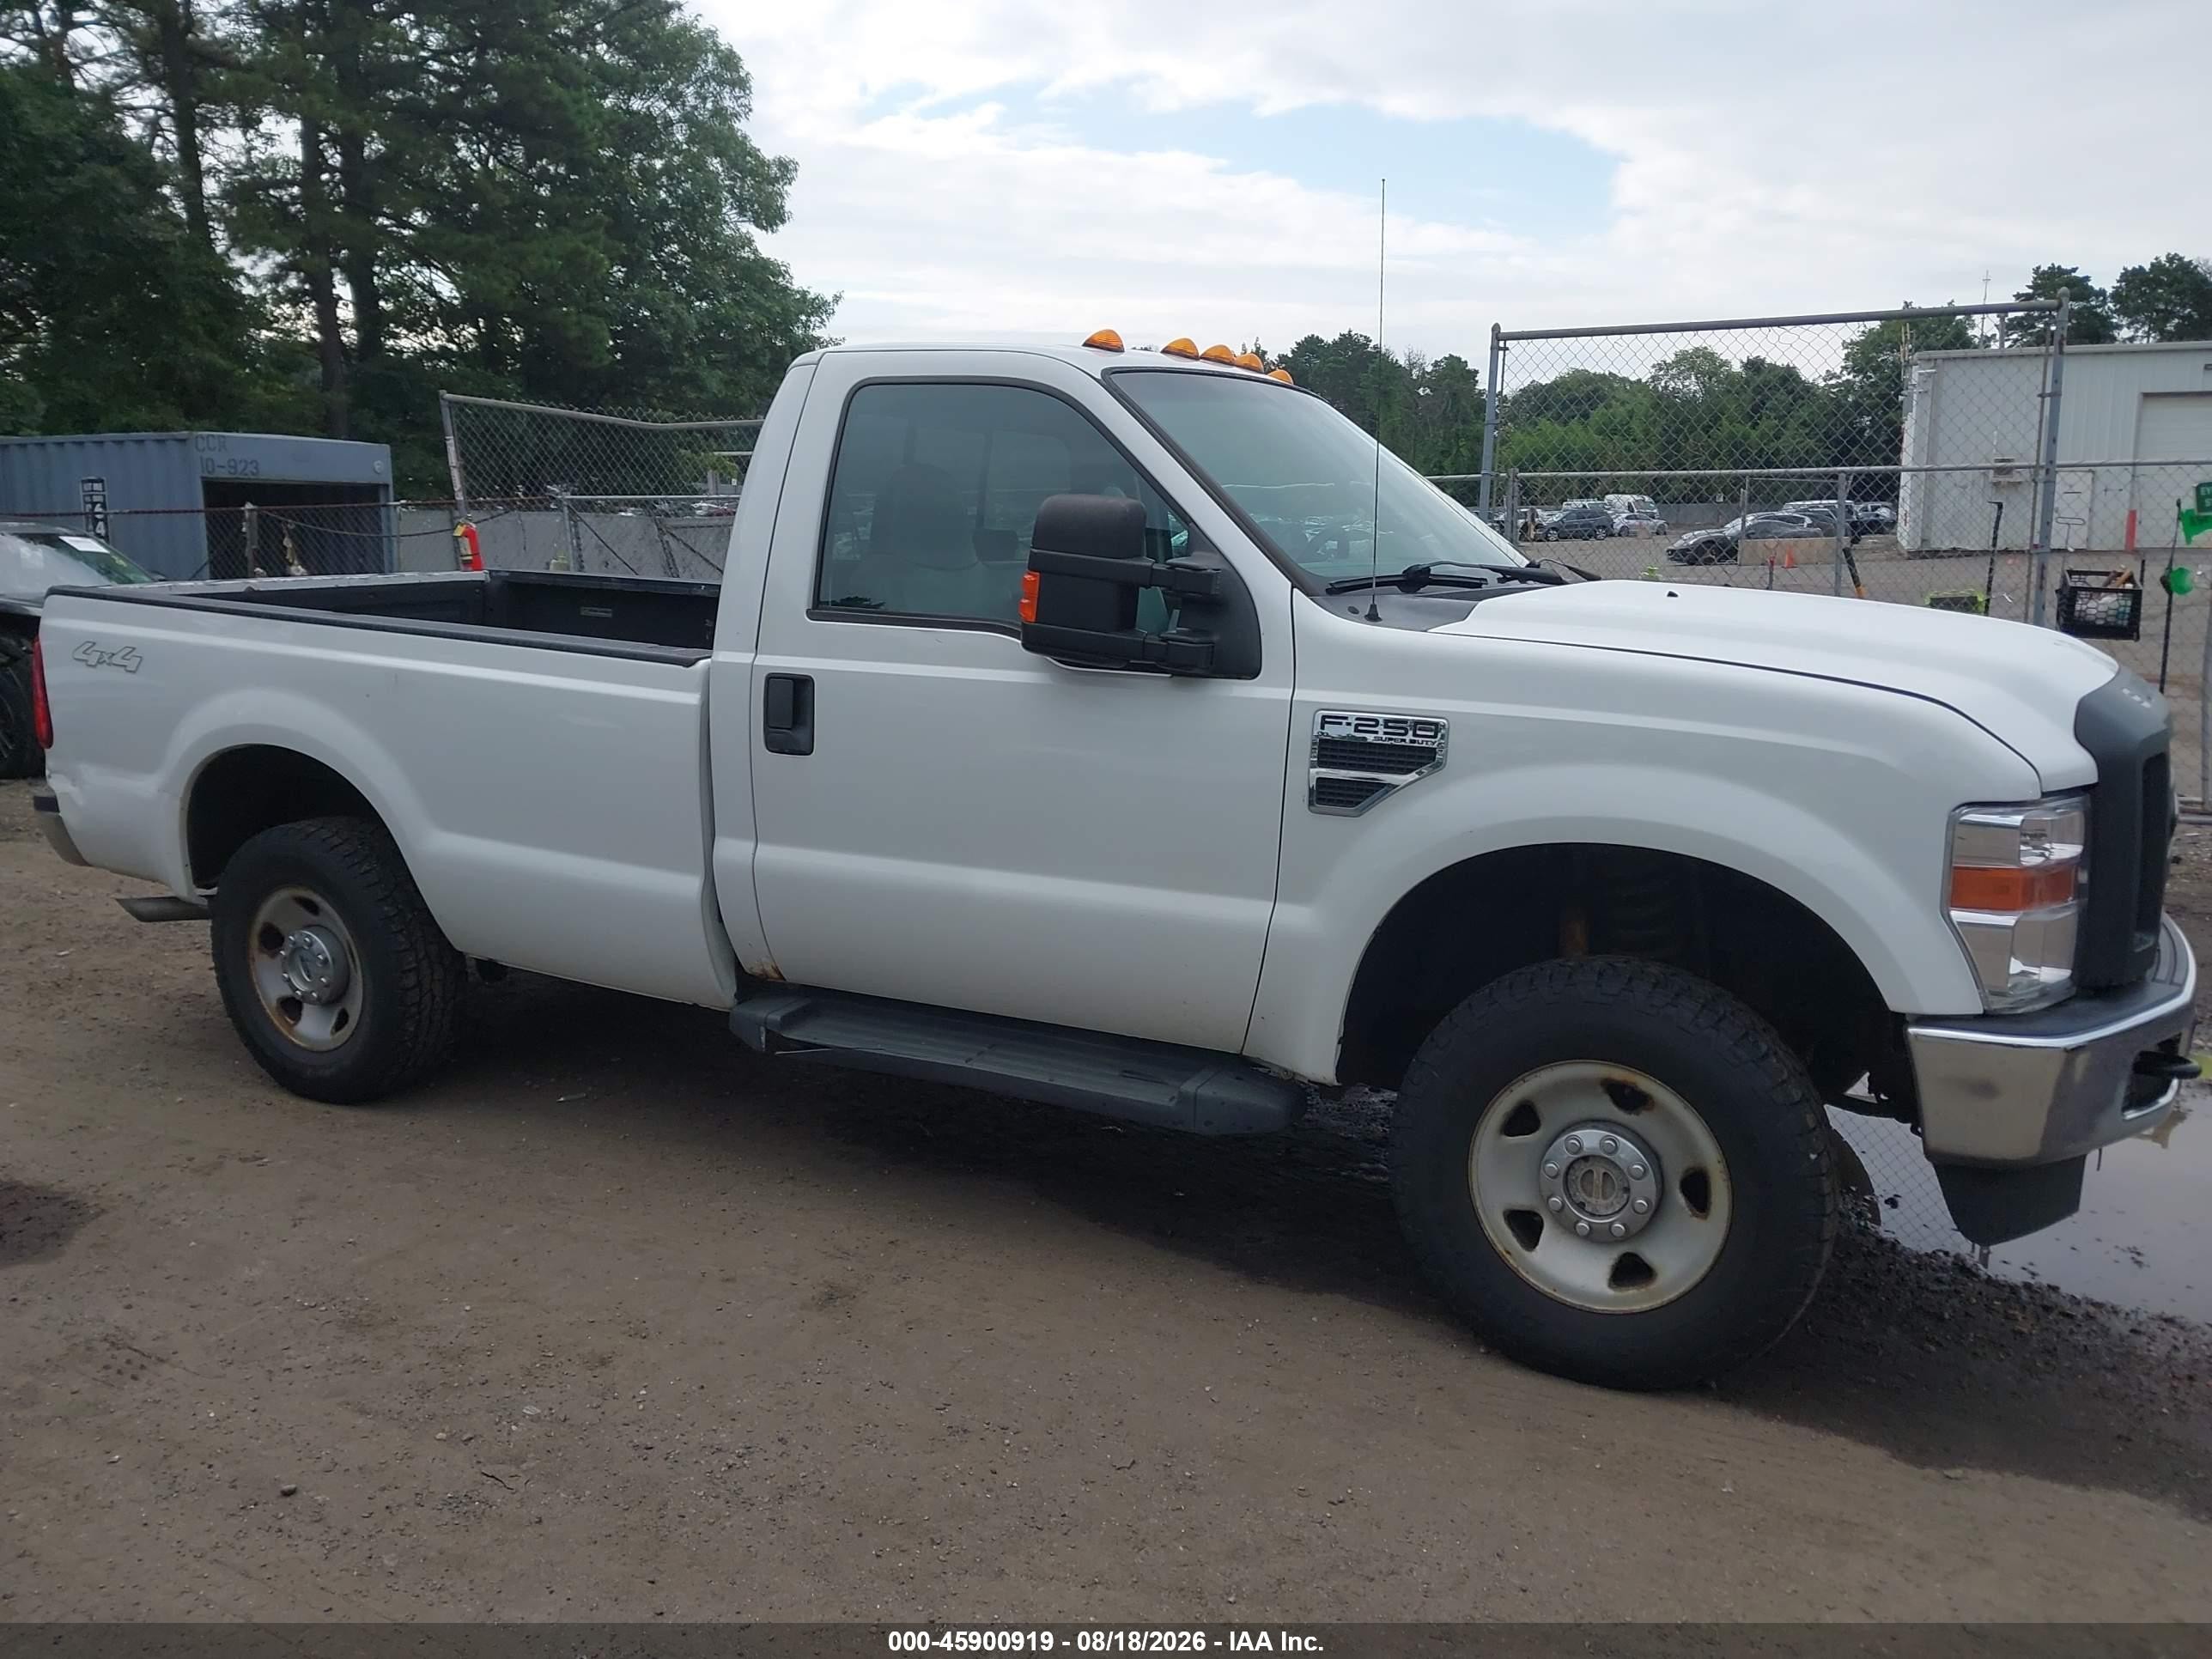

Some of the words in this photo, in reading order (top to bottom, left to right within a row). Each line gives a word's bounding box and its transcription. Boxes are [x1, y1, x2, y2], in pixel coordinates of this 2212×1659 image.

[1320, 714, 1439, 738] F-250
[1372, 736, 1405, 744] SUPER
[1406, 738, 1437, 747] DUTY
